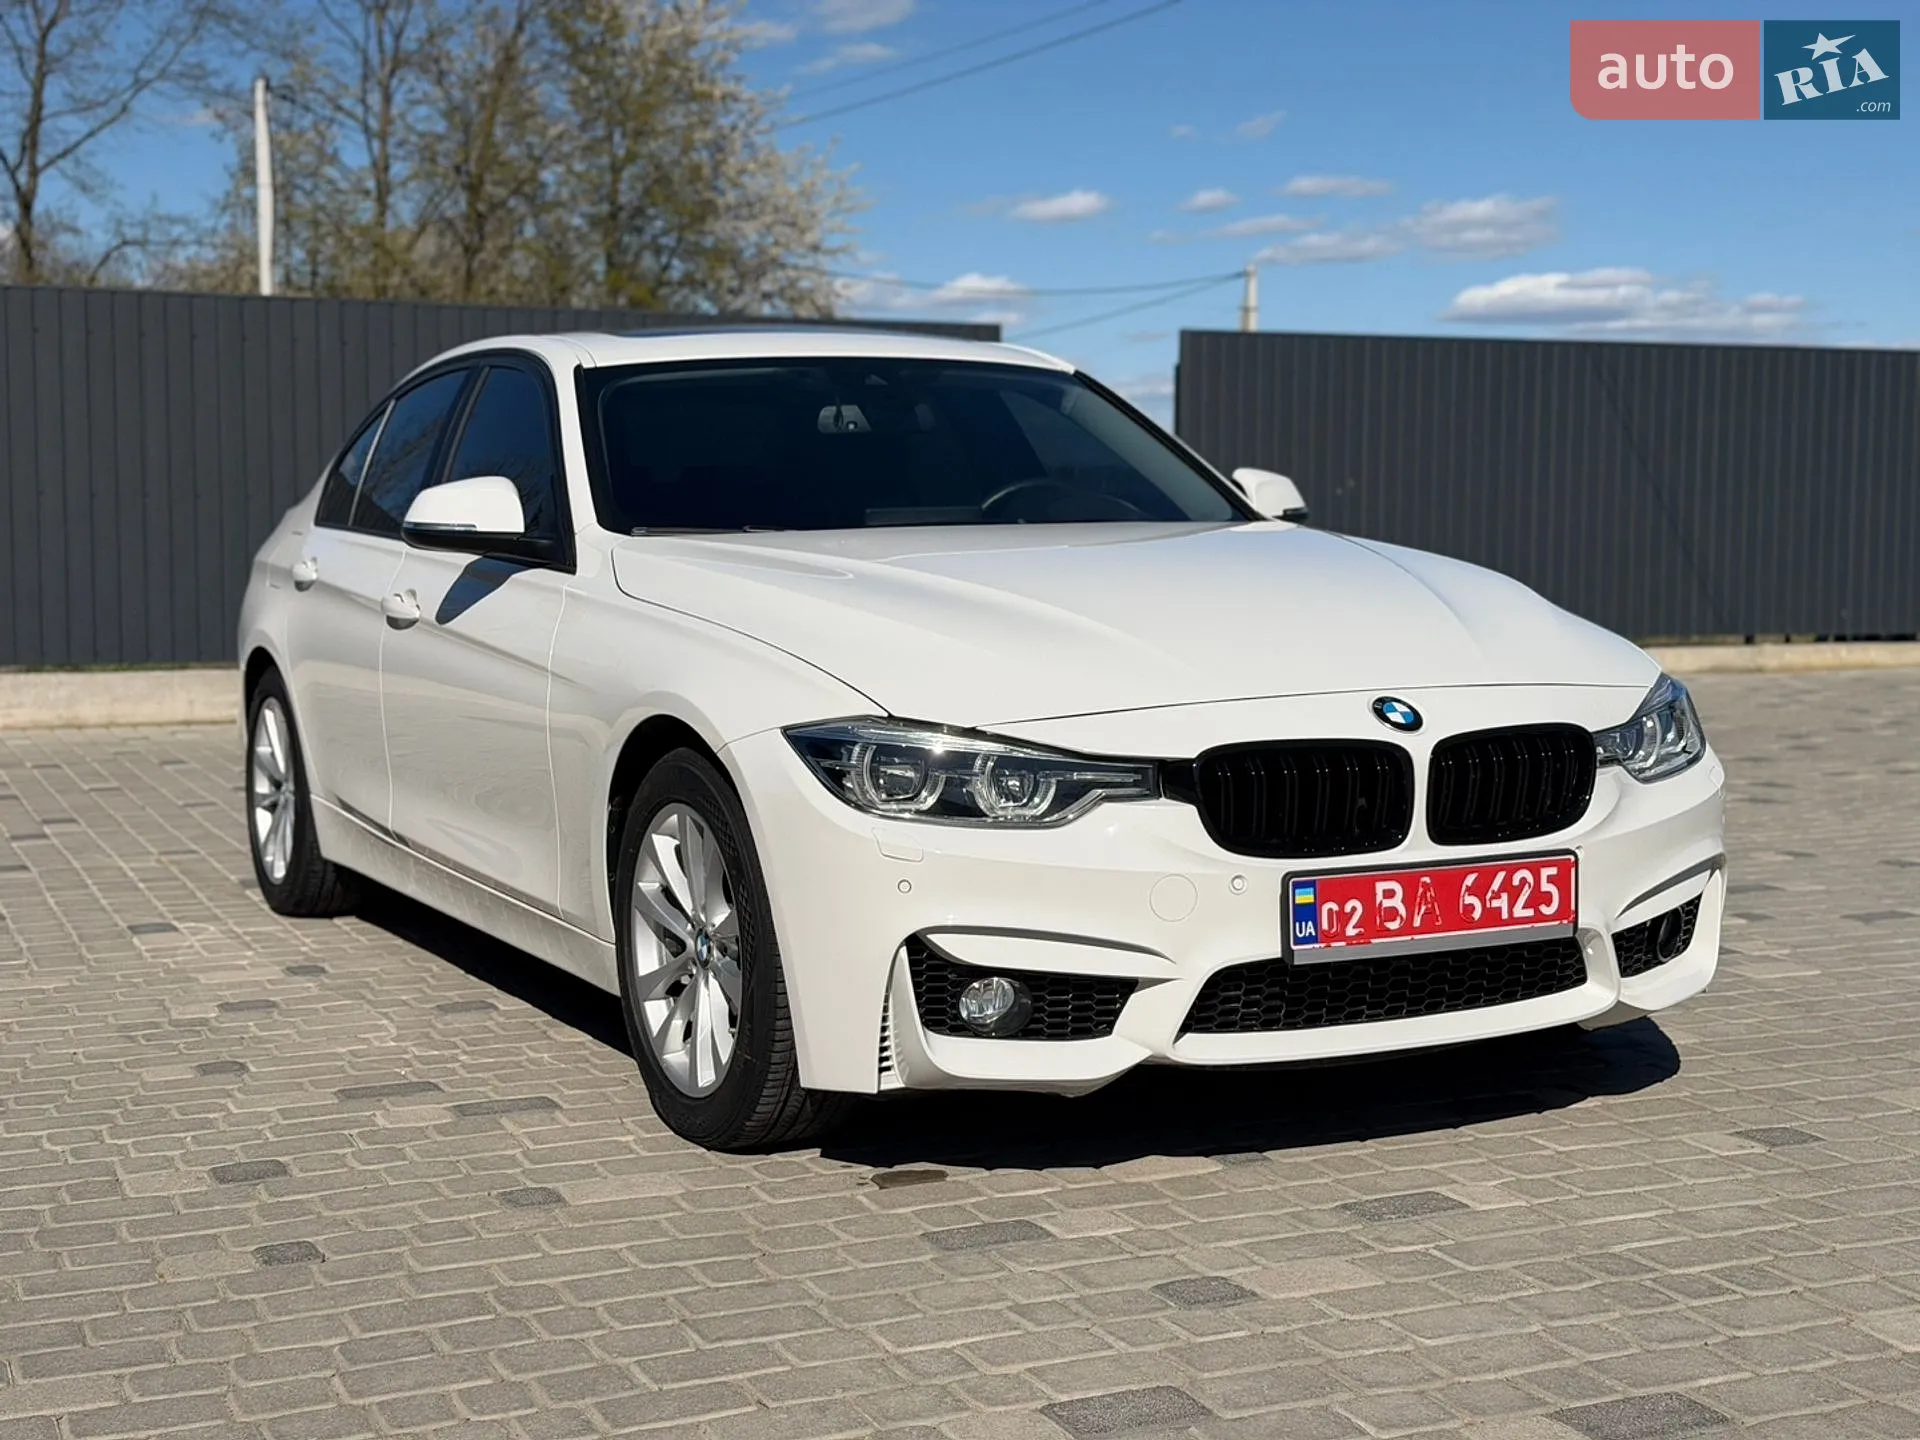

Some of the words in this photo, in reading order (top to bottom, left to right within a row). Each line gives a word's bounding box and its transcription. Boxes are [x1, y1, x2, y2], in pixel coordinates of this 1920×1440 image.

[1321, 899, 1364, 938] 02
[1375, 876, 1442, 932] BA
[1459, 867, 1560, 923] 6425
[1295, 921, 1316, 938] UA
